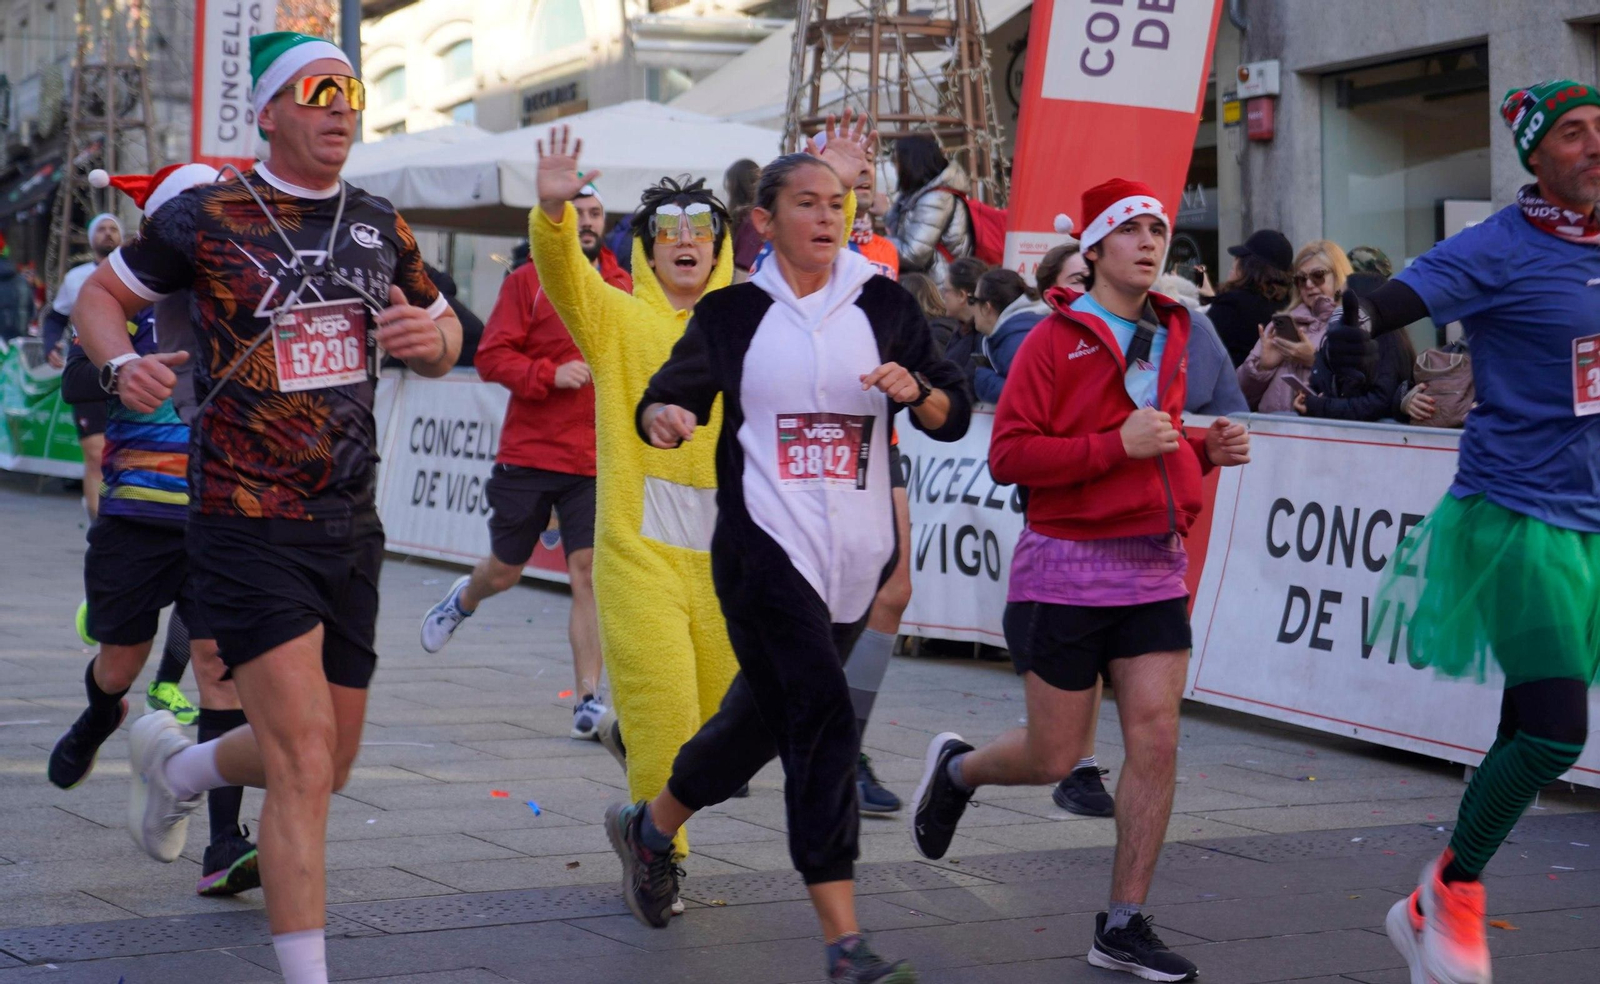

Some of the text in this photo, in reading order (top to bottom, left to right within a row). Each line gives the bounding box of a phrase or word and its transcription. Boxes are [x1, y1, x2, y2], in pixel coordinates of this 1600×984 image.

[1079, 0, 1124, 77] CO
[1520, 86, 1588, 150] HO HO
[291, 336, 360, 376] 5236
[1068, 345, 1099, 360] MERCURY
[411, 470, 442, 508] DE
[915, 523, 1001, 582] VIGO
[1276, 584, 1343, 652] DE
